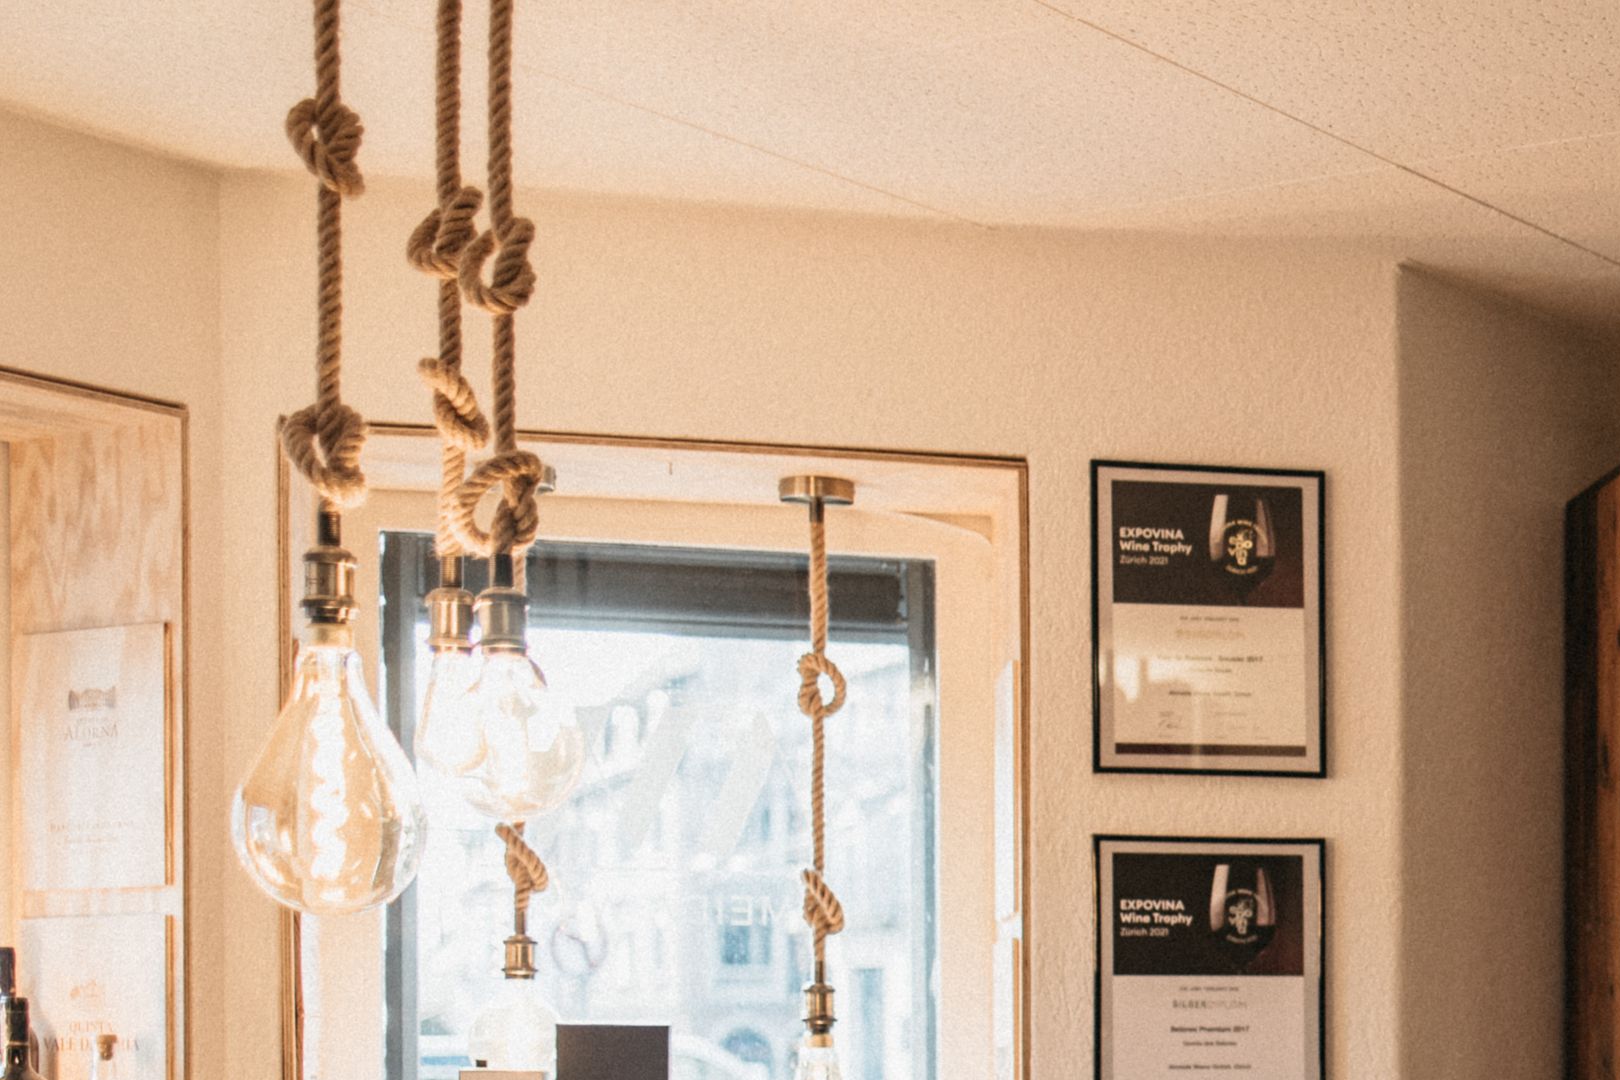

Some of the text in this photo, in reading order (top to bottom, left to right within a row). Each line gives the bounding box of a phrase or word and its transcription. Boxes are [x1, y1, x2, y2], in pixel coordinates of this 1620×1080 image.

[1119, 527, 1185, 540] EXPOVINA
[1119, 540, 1193, 556] Wine Trophy
[1119, 899, 1185, 912] EXPOVINA
[1119, 912, 1193, 927] Wine Trophy
